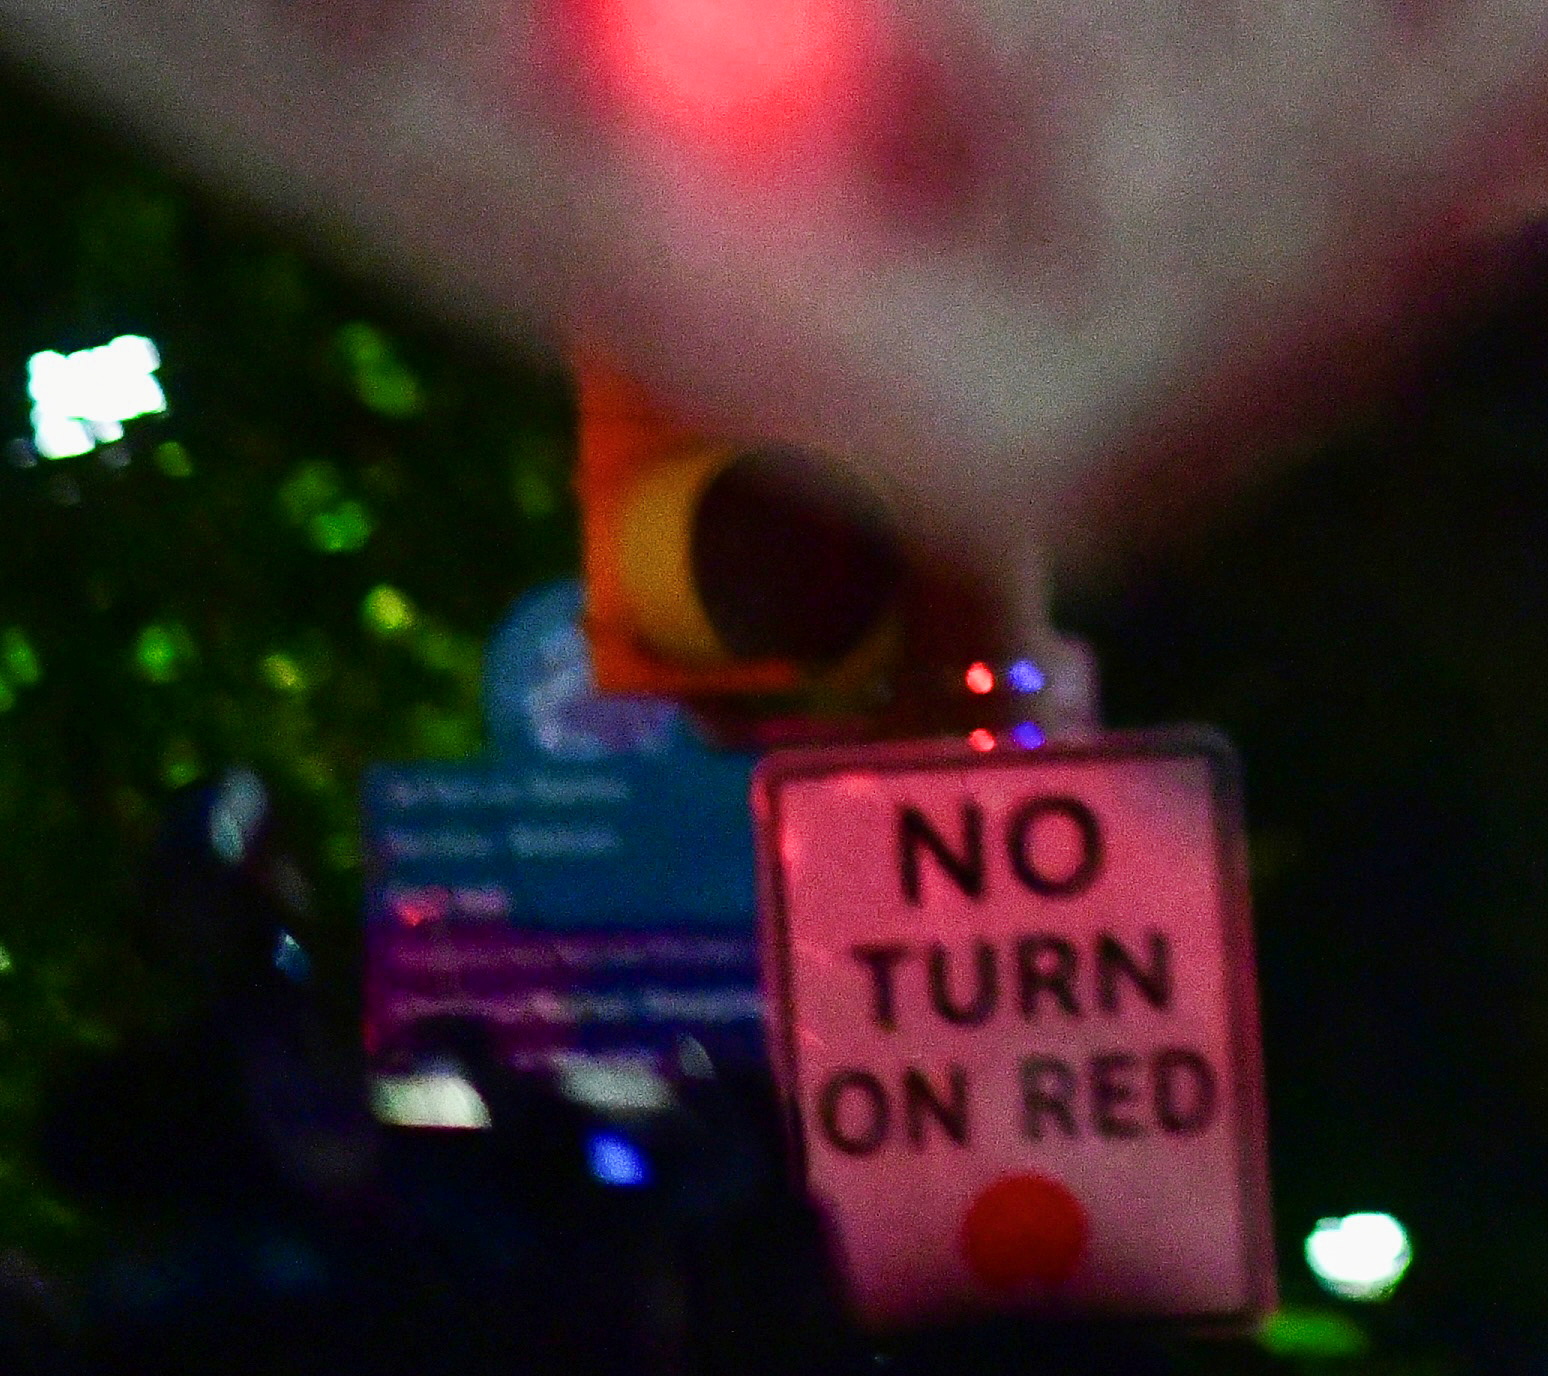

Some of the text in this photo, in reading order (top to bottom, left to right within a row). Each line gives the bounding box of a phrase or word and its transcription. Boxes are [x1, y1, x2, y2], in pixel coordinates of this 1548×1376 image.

[898, 794, 1105, 908] NO
[854, 928, 1174, 1032] TURN
[817, 1050, 1219, 1154] ON RED
